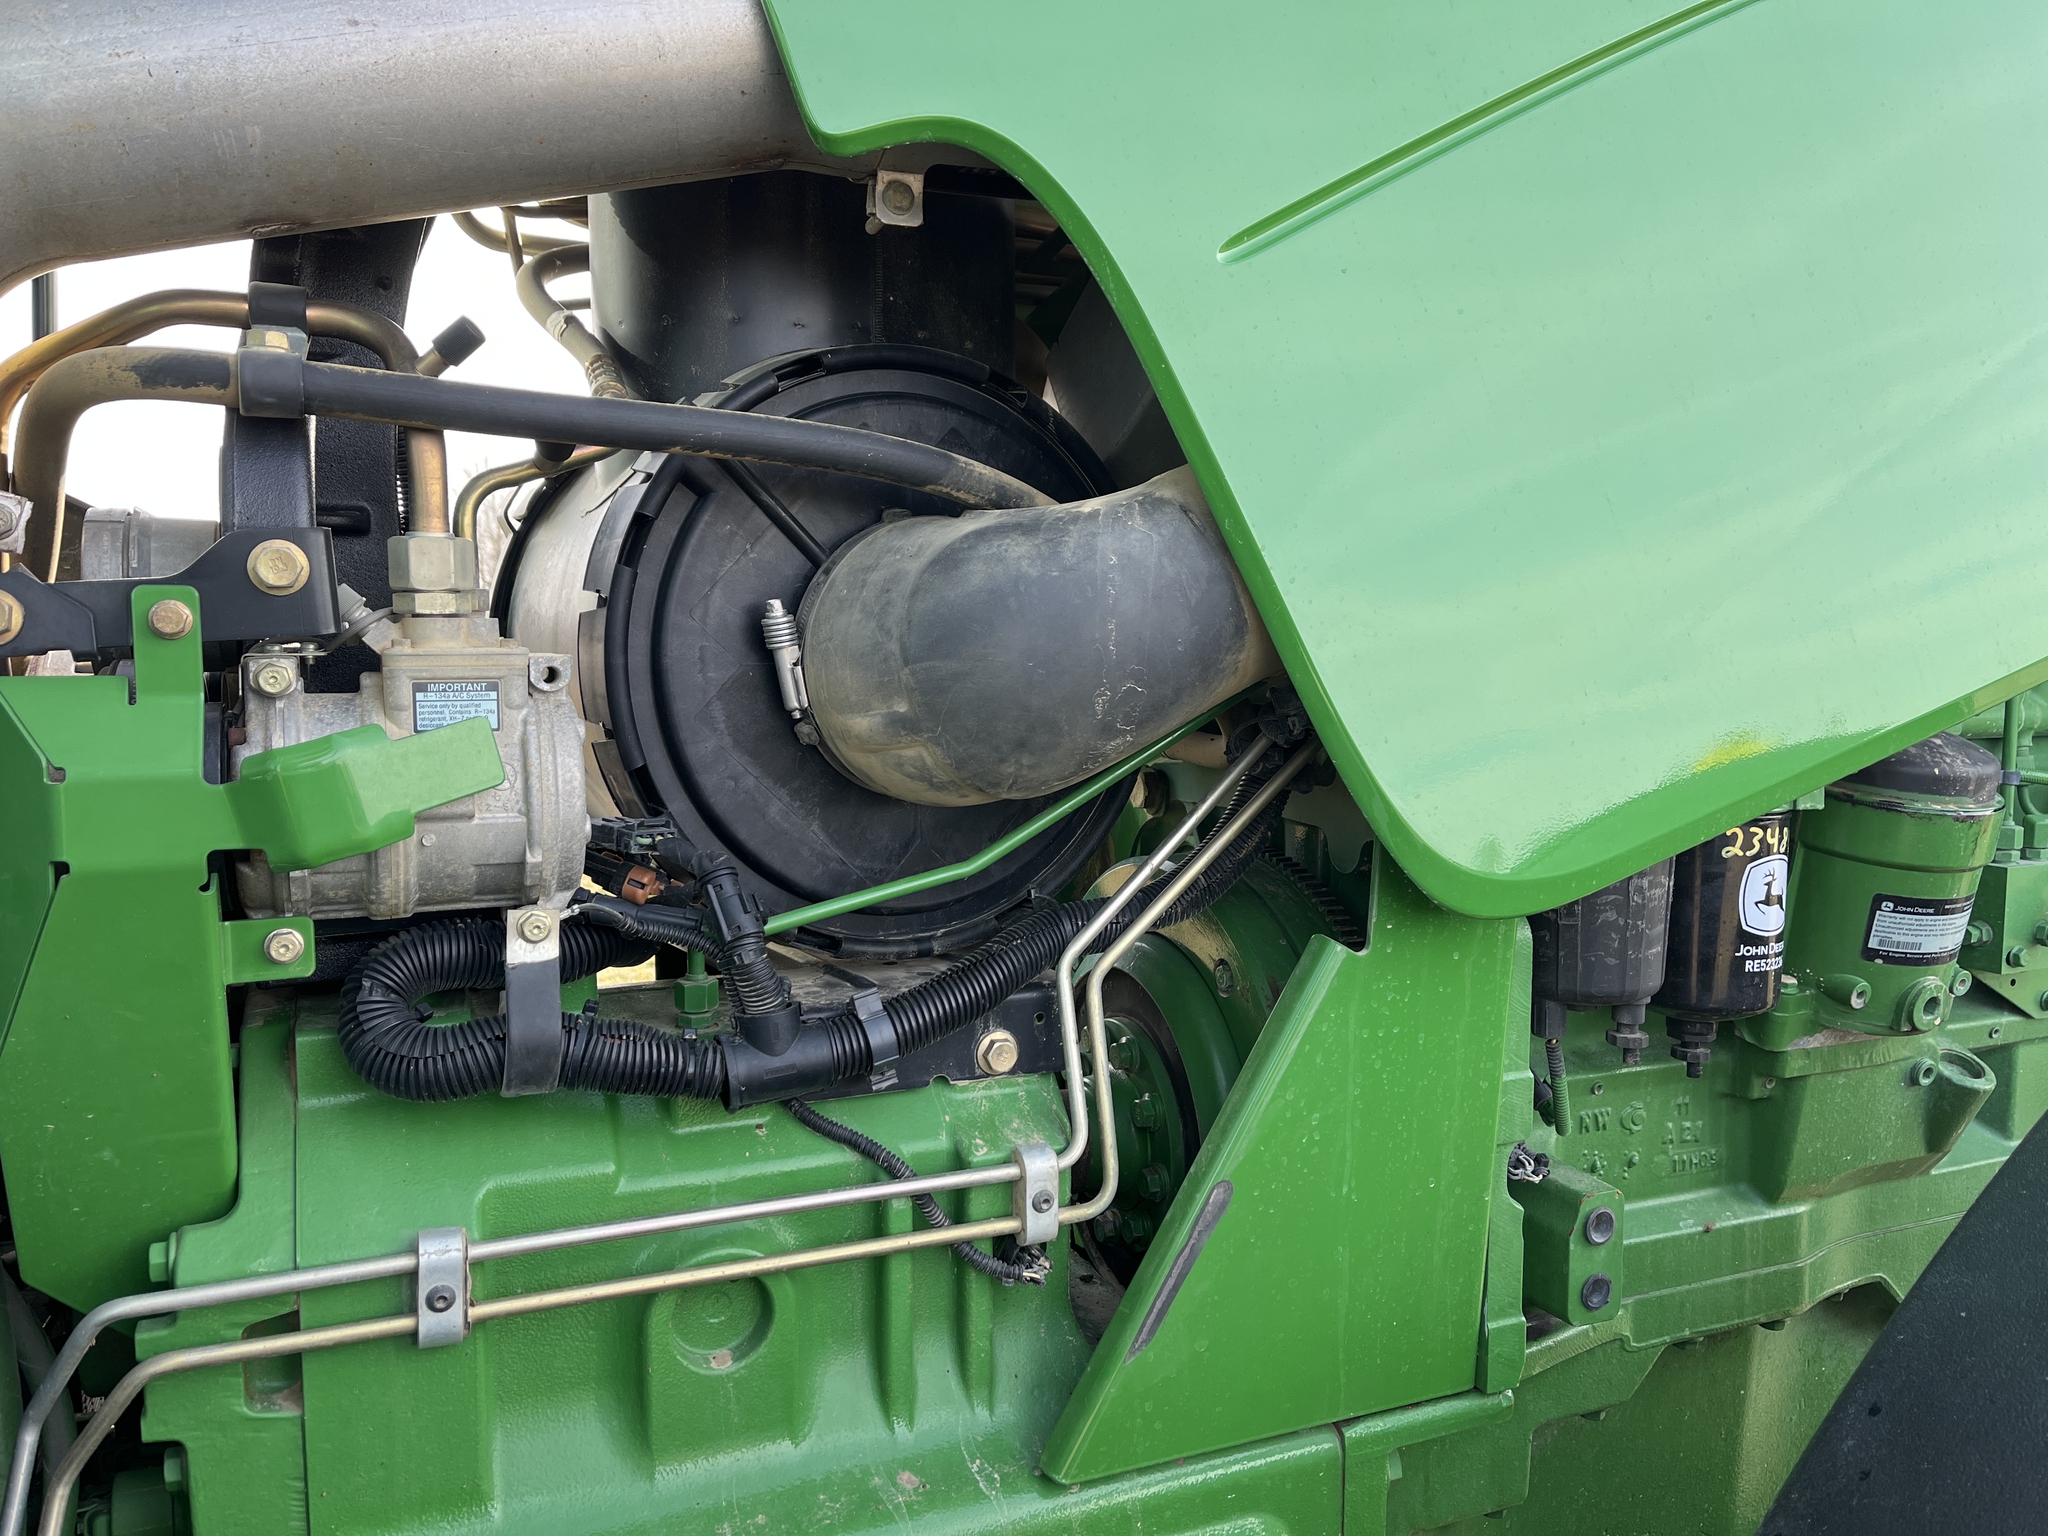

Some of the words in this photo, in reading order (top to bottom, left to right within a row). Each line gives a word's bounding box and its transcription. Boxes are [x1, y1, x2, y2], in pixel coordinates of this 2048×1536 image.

[427, 683, 487, 692] IMPORTANT
[466, 692, 491, 700] System
[451, 702, 458, 710] by
[459, 702, 482, 710] qualified
[418, 715, 448, 723] refrigerant,
[1721, 827, 1789, 858] 2348
[1894, 905, 1914, 913] JOHN
[1914, 906, 1936, 914] DEERE
[1878, 913, 1899, 921] Warranty
[1735, 944, 1769, 957] JOHN
